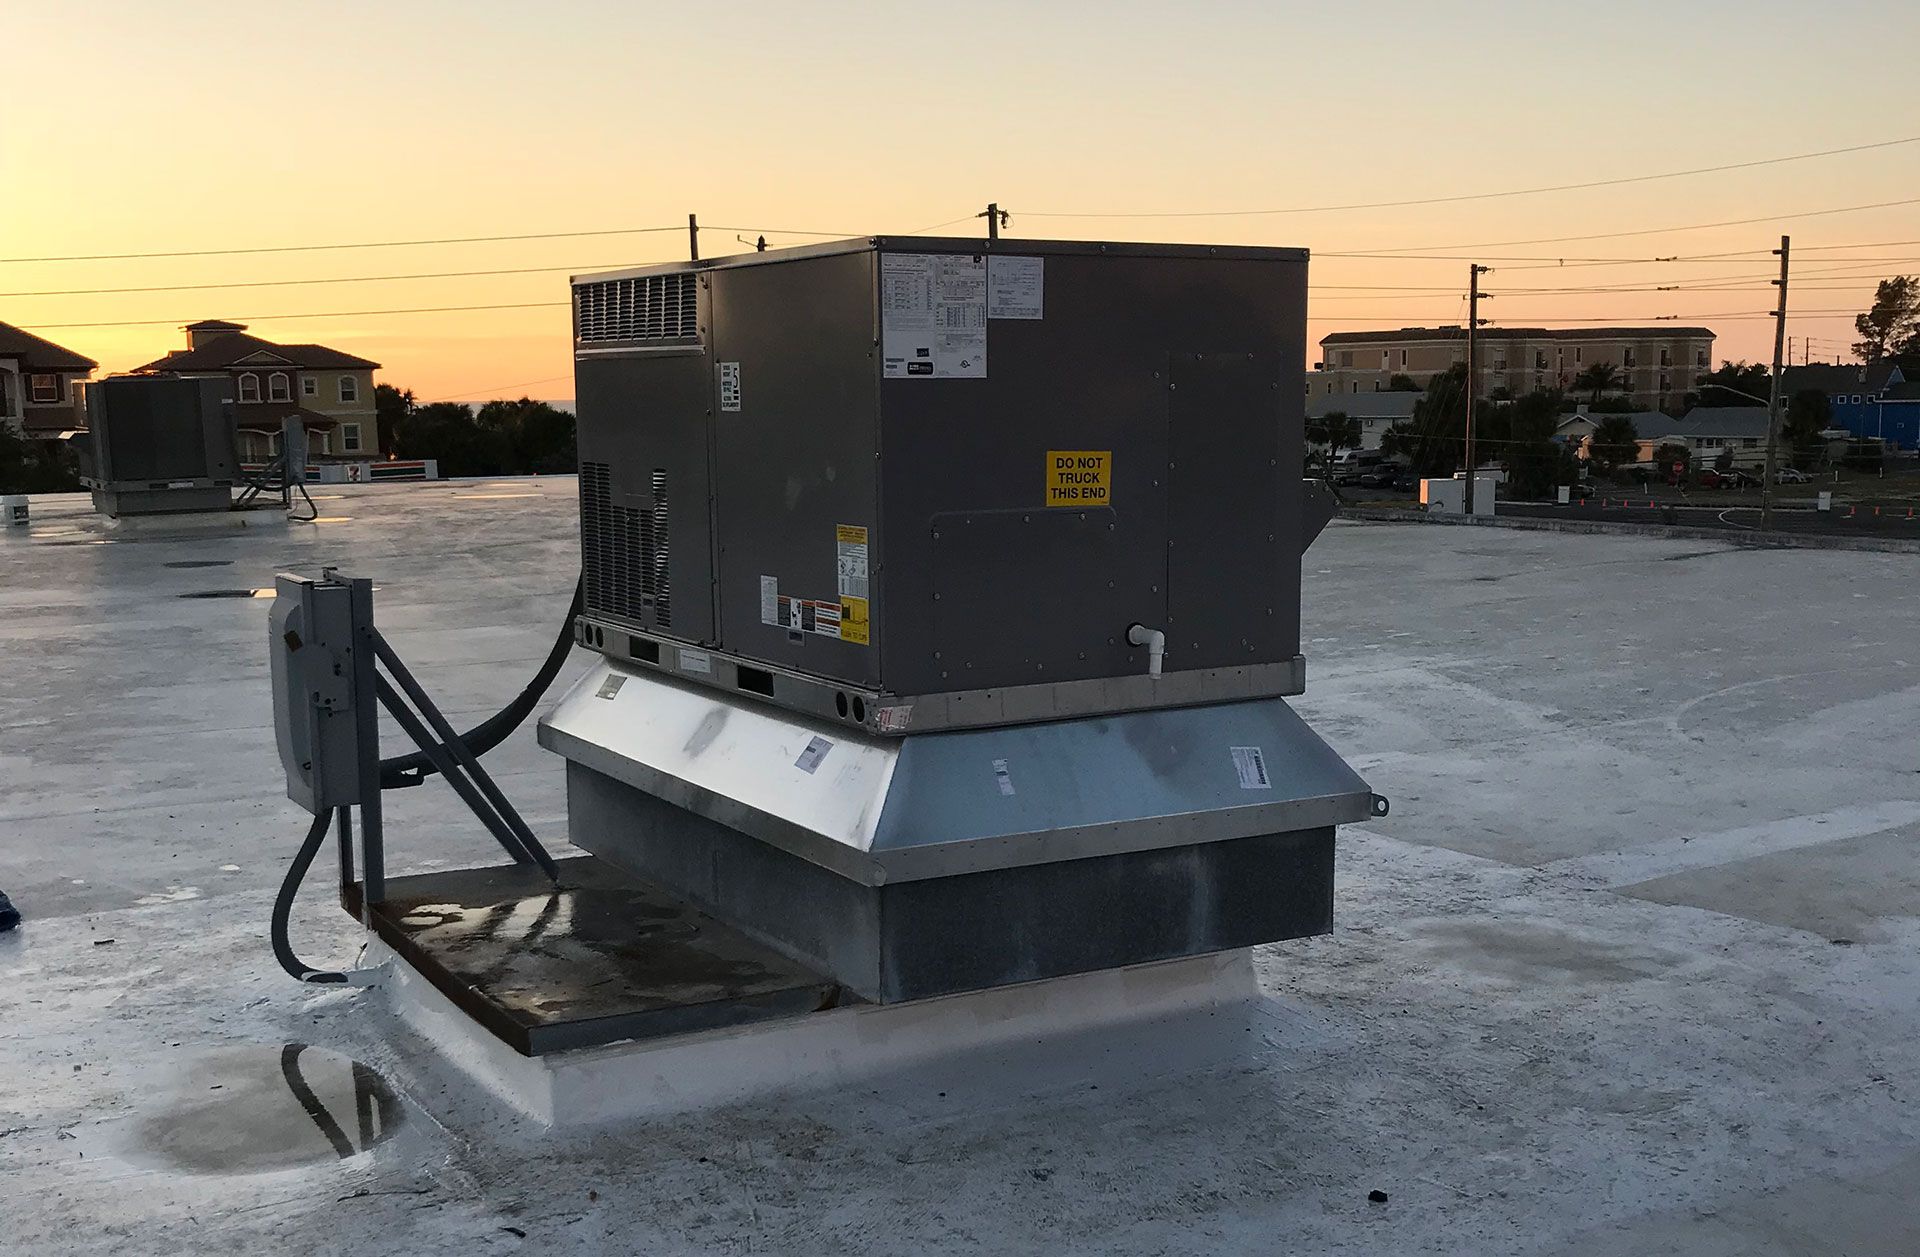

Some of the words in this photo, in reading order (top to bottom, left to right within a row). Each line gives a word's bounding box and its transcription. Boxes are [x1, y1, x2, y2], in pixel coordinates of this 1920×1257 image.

[1056, 457, 1074, 469] DO
[1077, 457, 1103, 469] NOT
[1058, 472, 1100, 484] TRUCK
[1051, 487, 1078, 499] THIS
[1082, 487, 1106, 499] END
